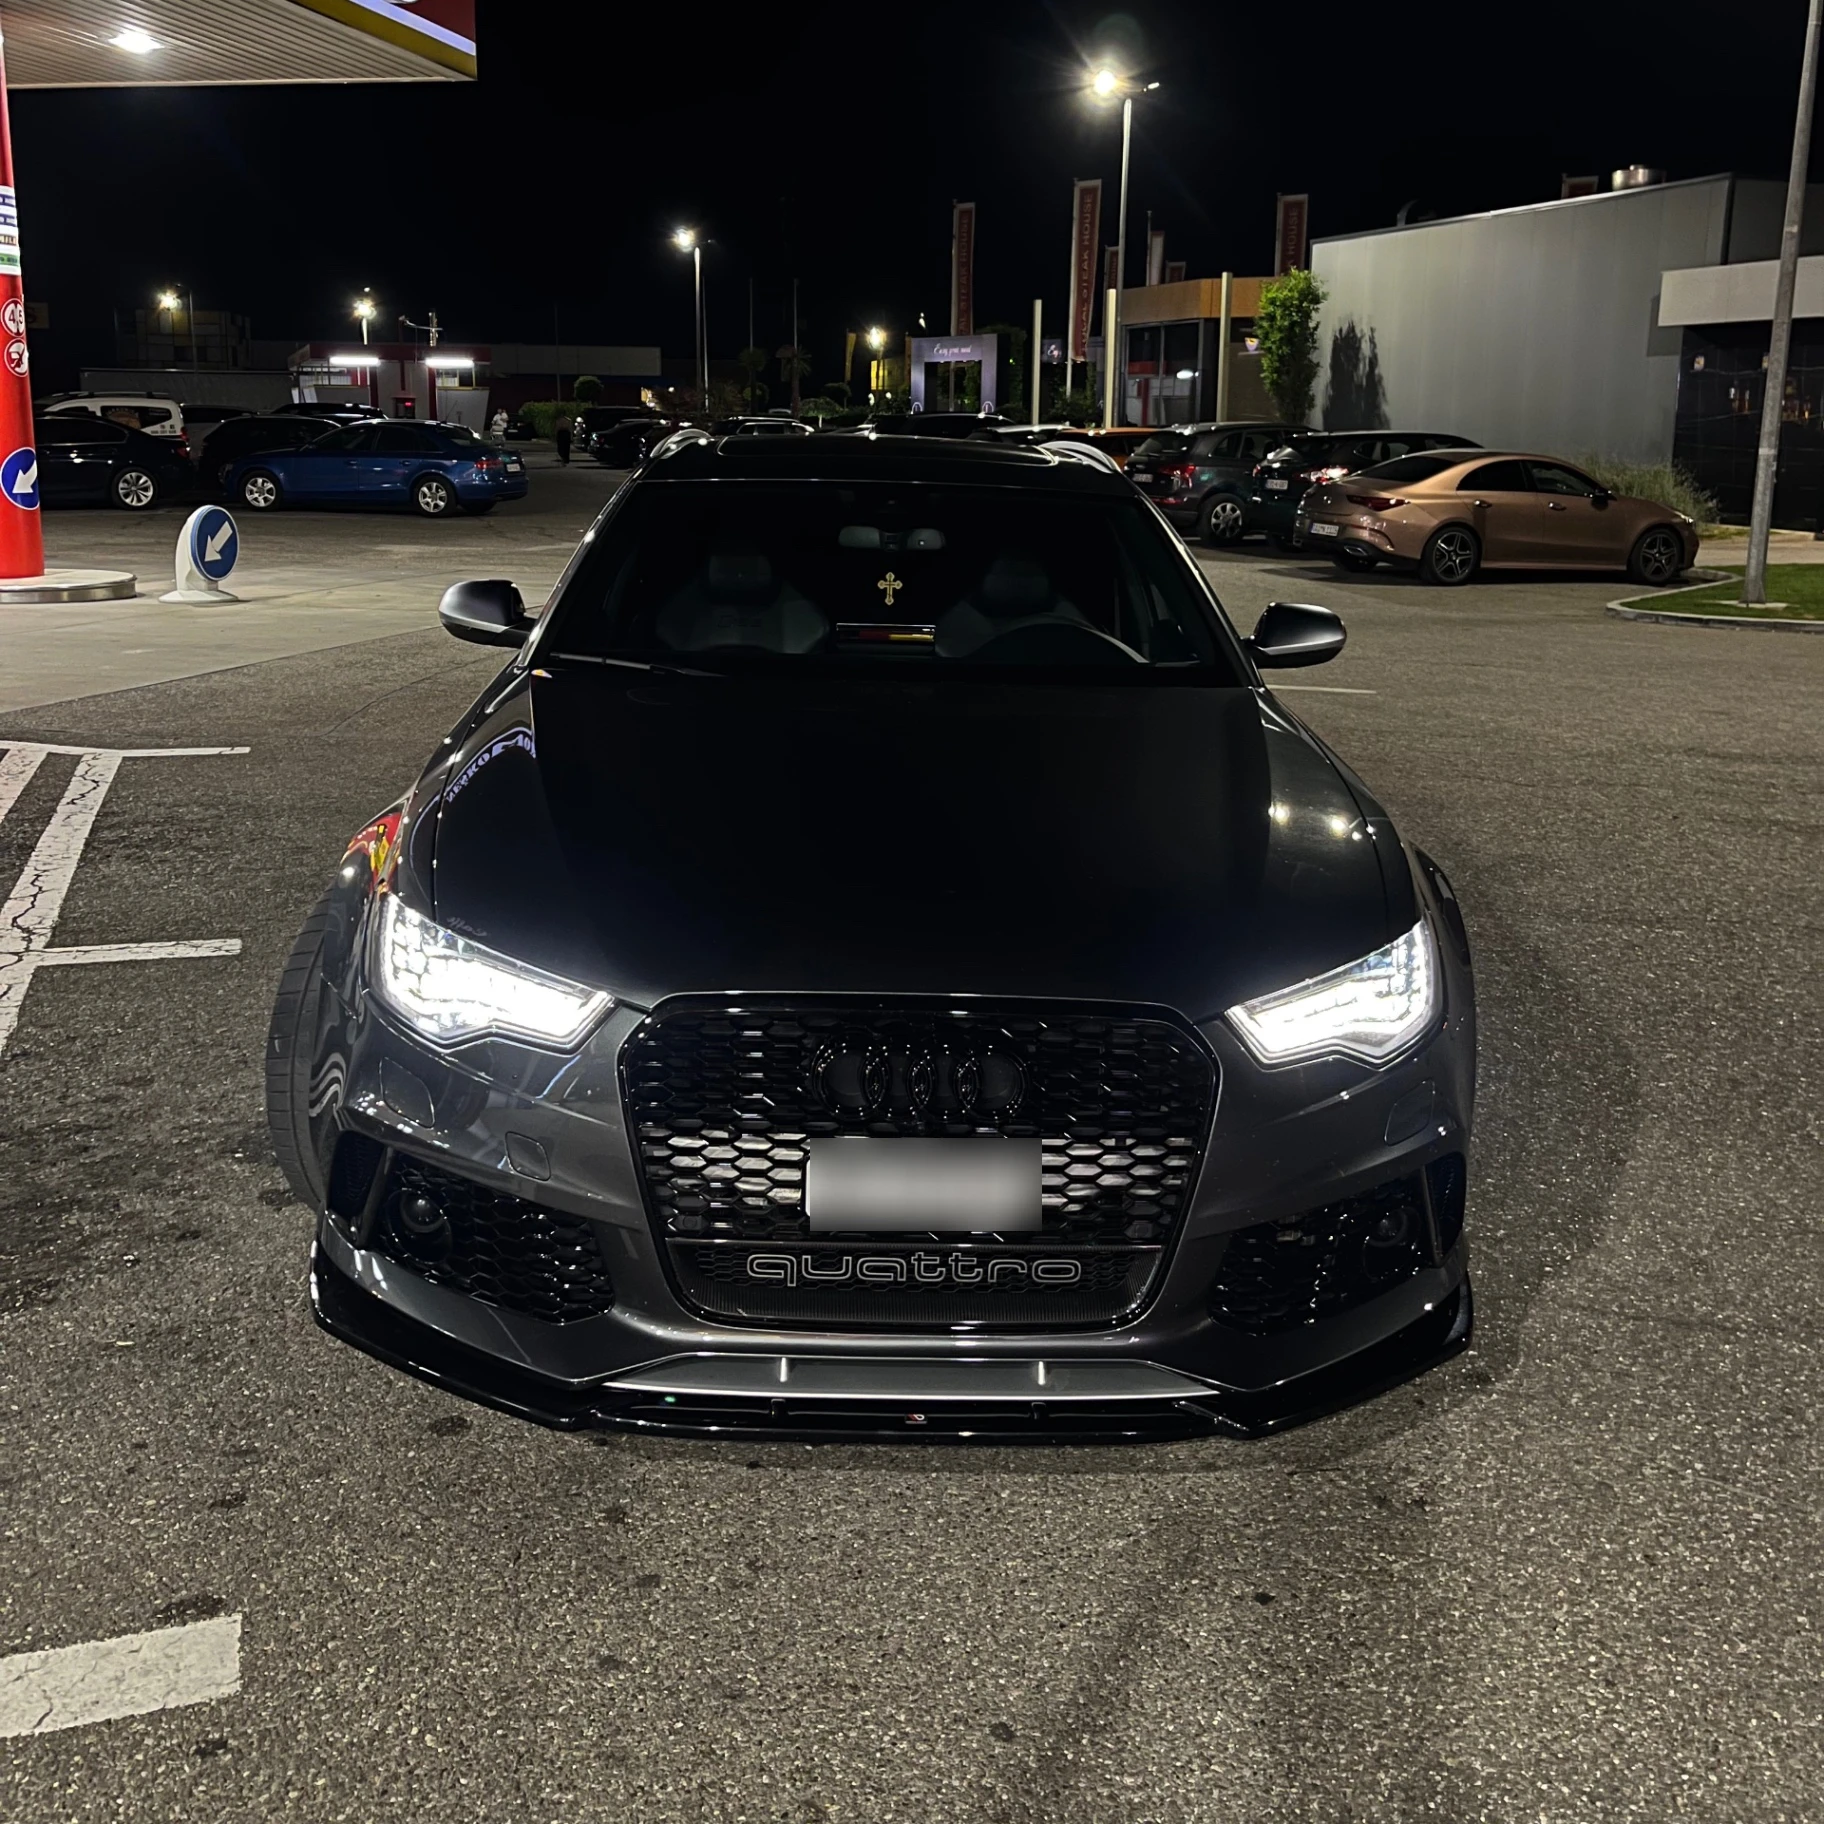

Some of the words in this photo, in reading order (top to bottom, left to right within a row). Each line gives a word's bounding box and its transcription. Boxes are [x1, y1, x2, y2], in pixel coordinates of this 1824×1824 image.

[959, 215, 969, 262] HOUSE
[1082, 193, 1092, 245] HOUSE
[1287, 207, 1298, 255] HOUSE
[8, 309, 16, 324] 4
[745, 1252, 1082, 1288] quattro
